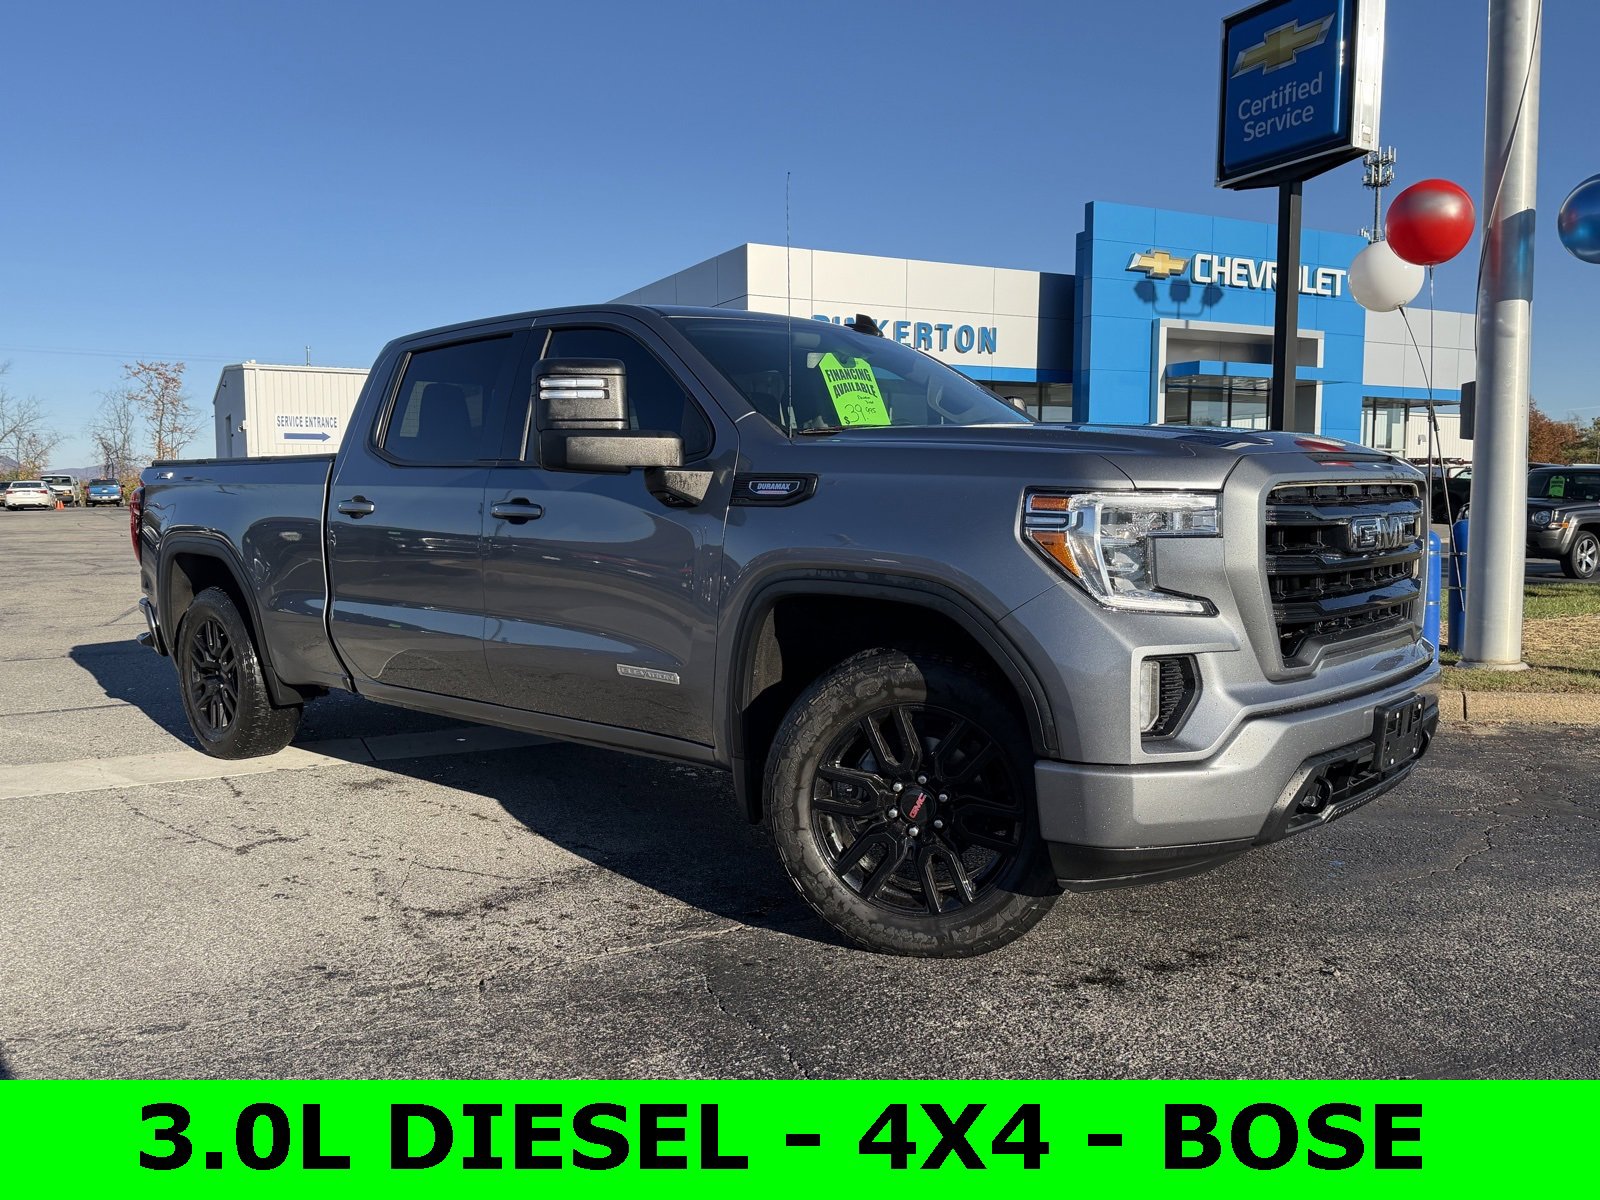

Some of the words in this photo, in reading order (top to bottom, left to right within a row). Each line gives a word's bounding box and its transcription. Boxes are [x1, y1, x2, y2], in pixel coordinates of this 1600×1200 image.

[1237, 72, 1323, 121] Certified
[1242, 105, 1315, 142] Service
[1194, 253, 1346, 297] CHEVRLET
[825, 368, 873, 383] FINANCING
[832, 382, 878, 399] AVAILABLE
[276, 415, 304, 428] SERVICE
[305, 416, 338, 429] ENTRANCE
[756, 483, 791, 491] DURAMAX
[1348, 515, 1416, 552] GMC
[909, 792, 927, 819] GMC
